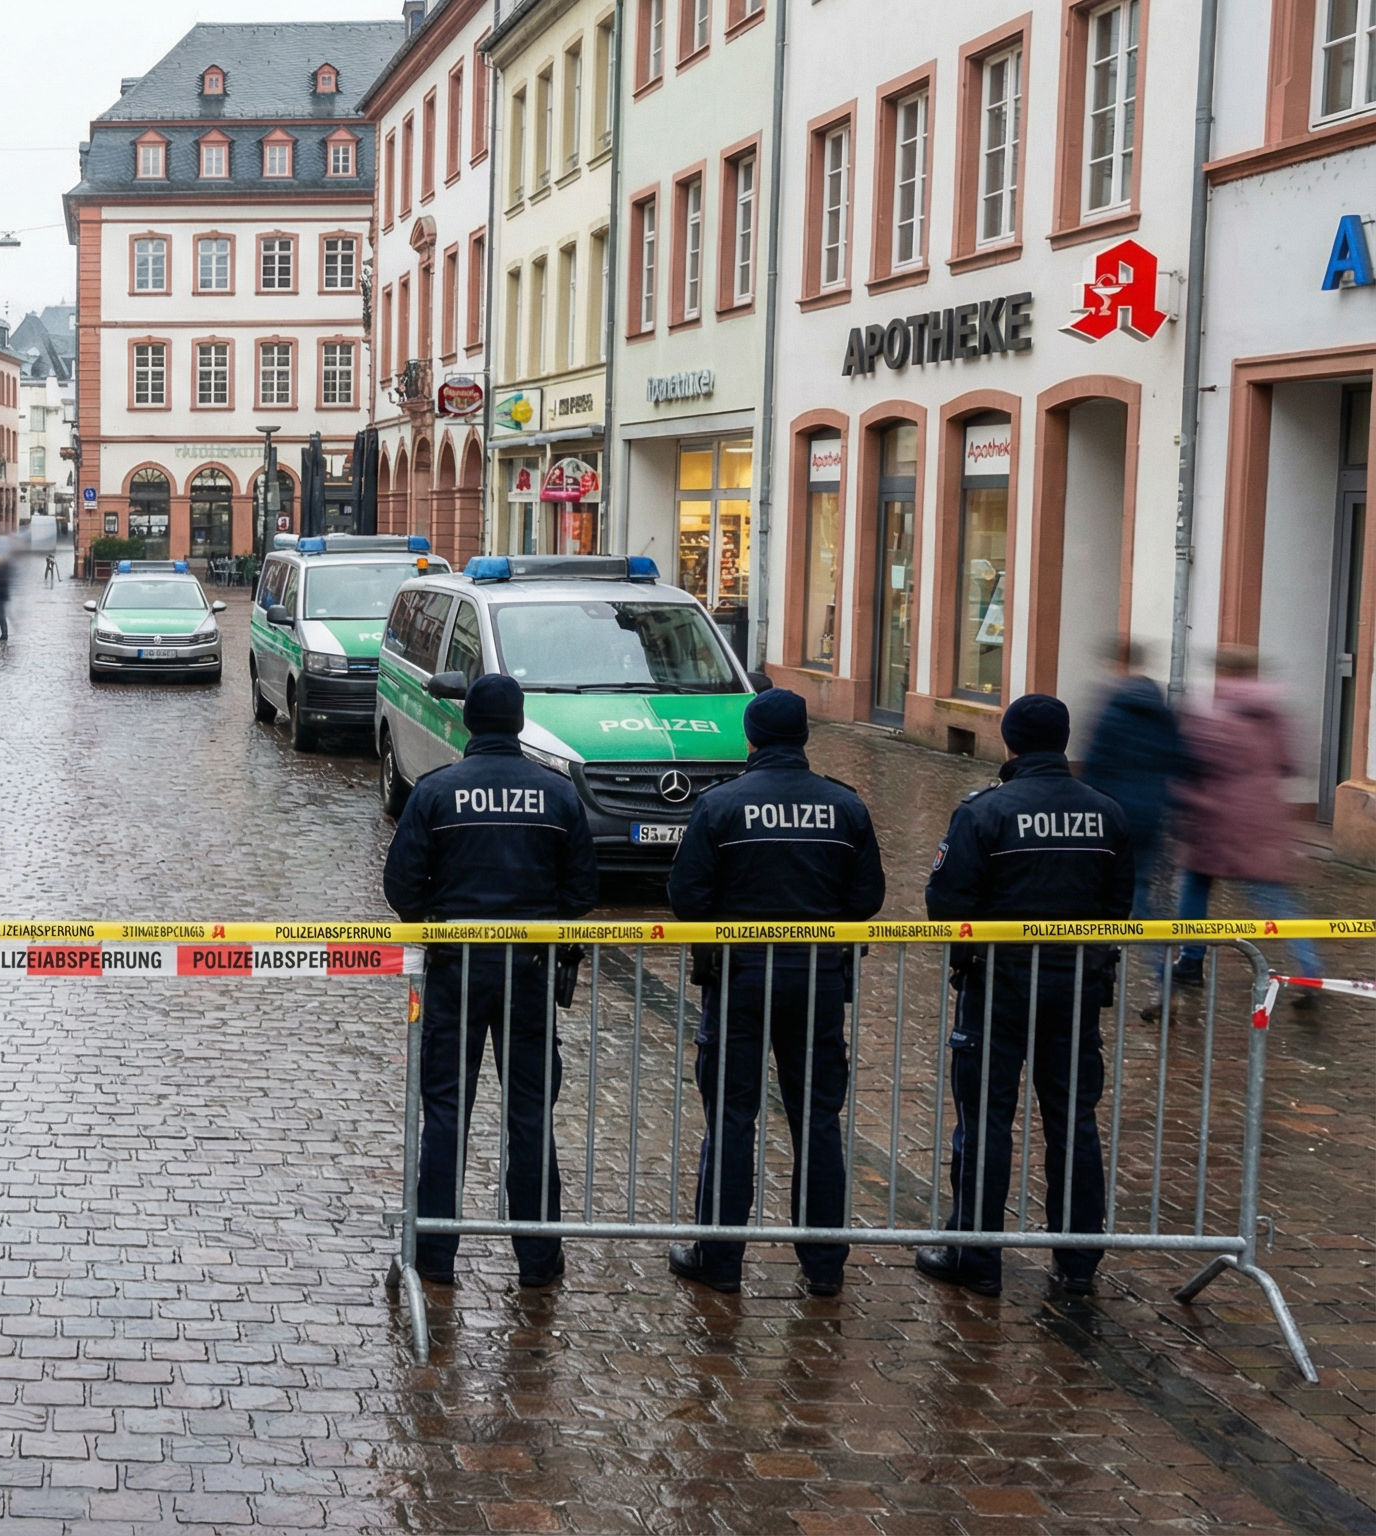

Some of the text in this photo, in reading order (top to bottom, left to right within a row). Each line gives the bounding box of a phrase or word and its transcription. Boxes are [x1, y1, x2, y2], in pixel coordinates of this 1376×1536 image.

[842, 291, 1034, 377] APOTHEKE
[598, 717, 722, 734] POLIZEI
[454, 788, 545, 814] POLIZEI
[744, 803, 835, 829] POLIZEI
[1017, 812, 1104, 839] POLIZEI
[275, 926, 392, 939] POLIZEIABSPERRUNG
[715, 926, 836, 939] POLIZEIABSPERRUNG
[1022, 923, 1144, 937] POLIZEIABSPERRUNG
[193, 950, 381, 969] POLIZEIABSPERRUNG
